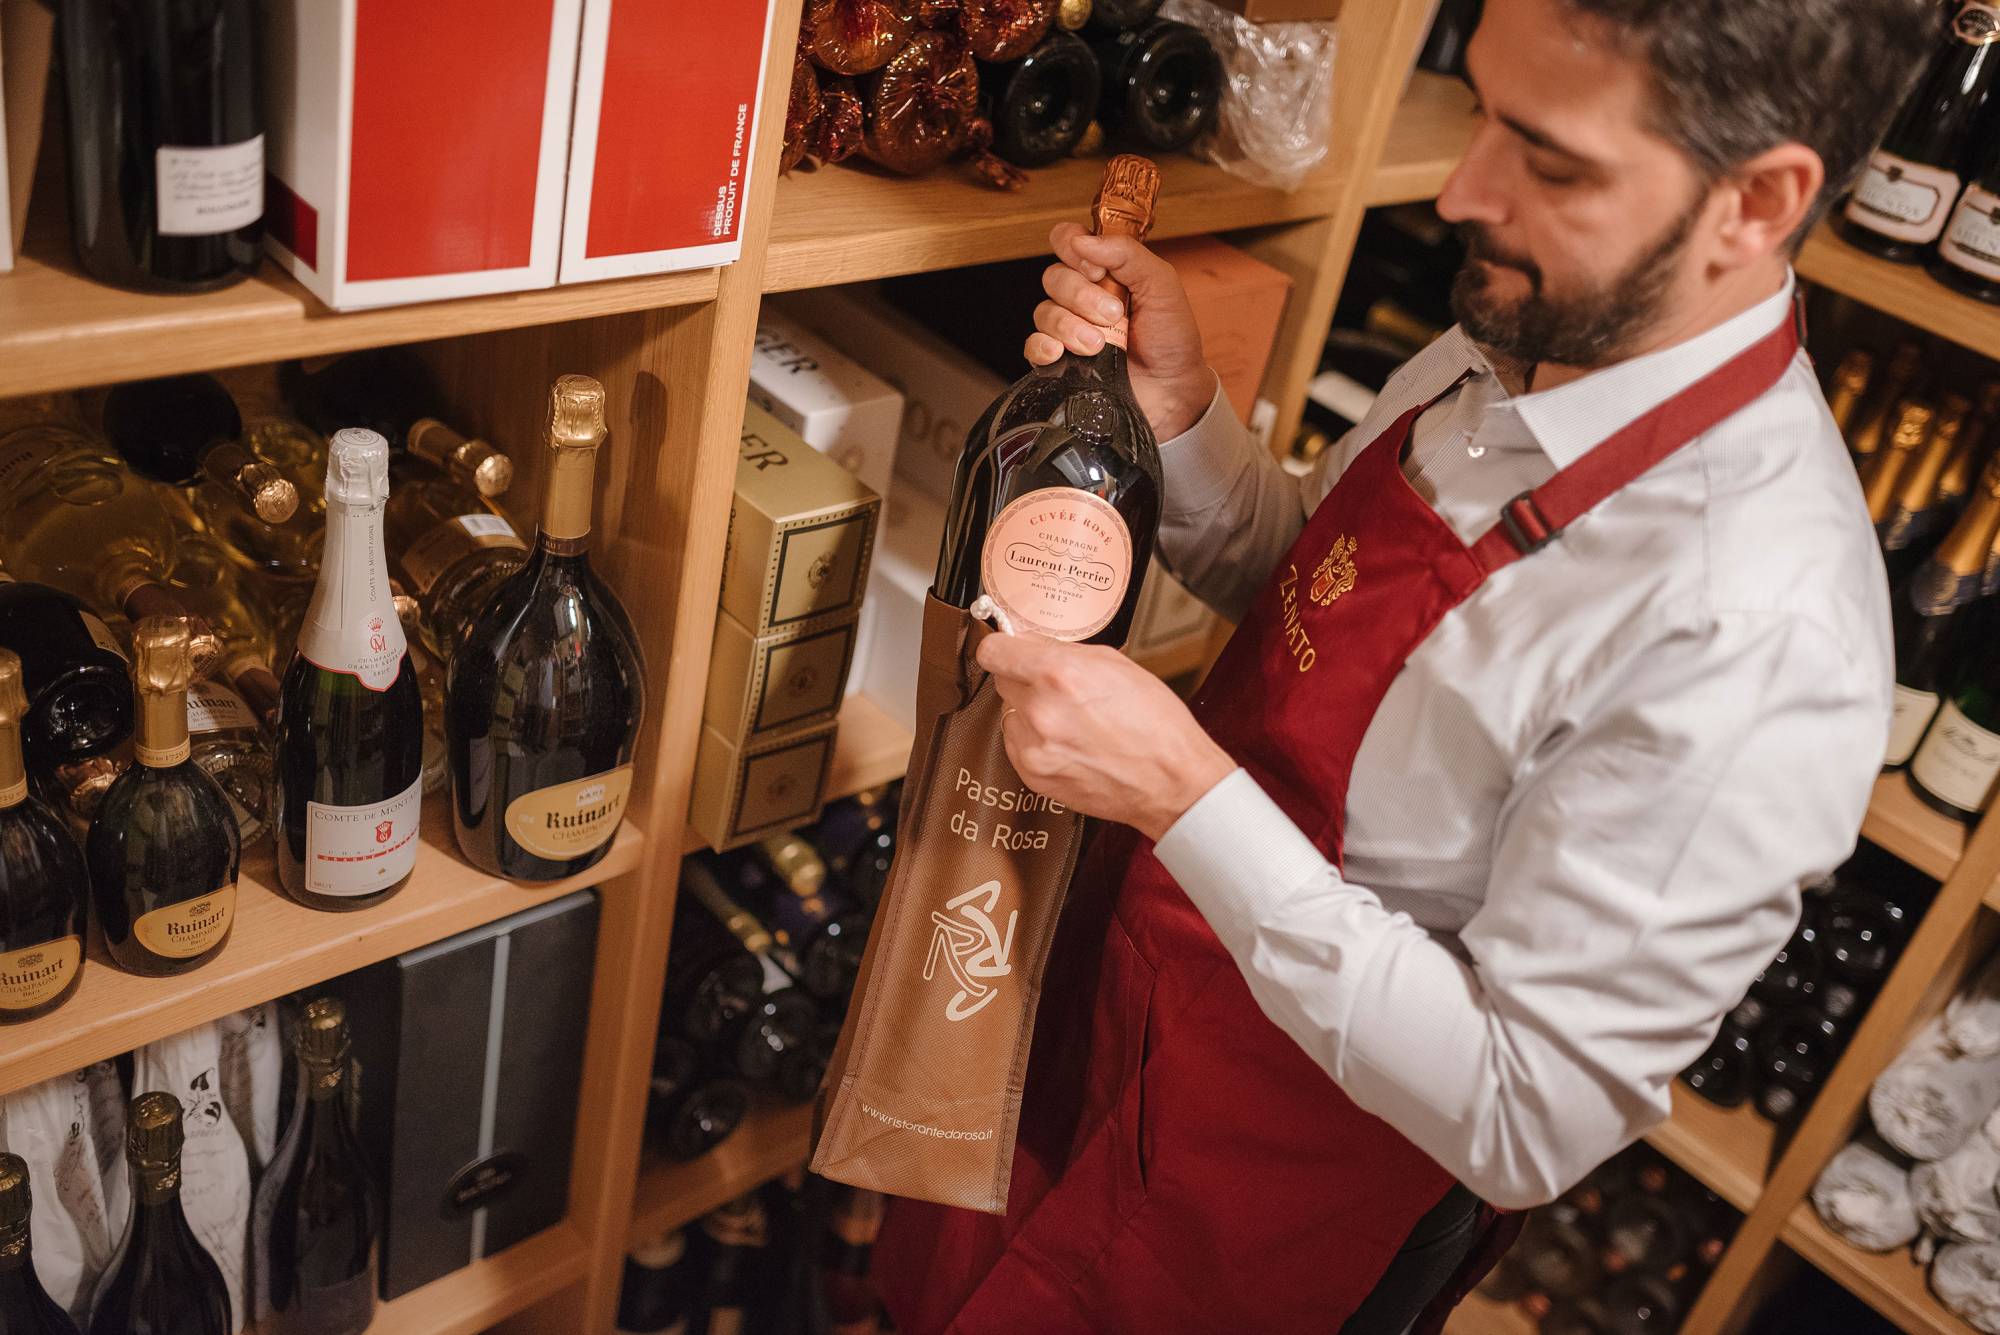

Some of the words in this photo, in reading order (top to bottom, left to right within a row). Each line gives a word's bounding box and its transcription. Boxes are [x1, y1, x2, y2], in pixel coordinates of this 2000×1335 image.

[733, 103, 748, 157] FRANCE
[731, 159, 740, 177] DE
[713, 185, 727, 236] DESSUS
[723, 180, 737, 235] PRODUIT
[1030, 510, 1077, 526] CUVÉE
[1083, 518, 1113, 546] ROSÉ
[1038, 532, 1098, 553] CHAMPAGNE
[1009, 550, 1110, 585] Laurent-Perrier
[1045, 592, 1068, 603] 1812
[1280, 564, 1316, 672] ZENATO
[955, 767, 1066, 815] Passione
[546, 794, 620, 829] Ruinart
[950, 810, 979, 842] da
[991, 823, 1049, 851] Rosa
[167, 907, 225, 935] Ruinart
[862, 1103, 994, 1141] www.ristorantedarosa.it
